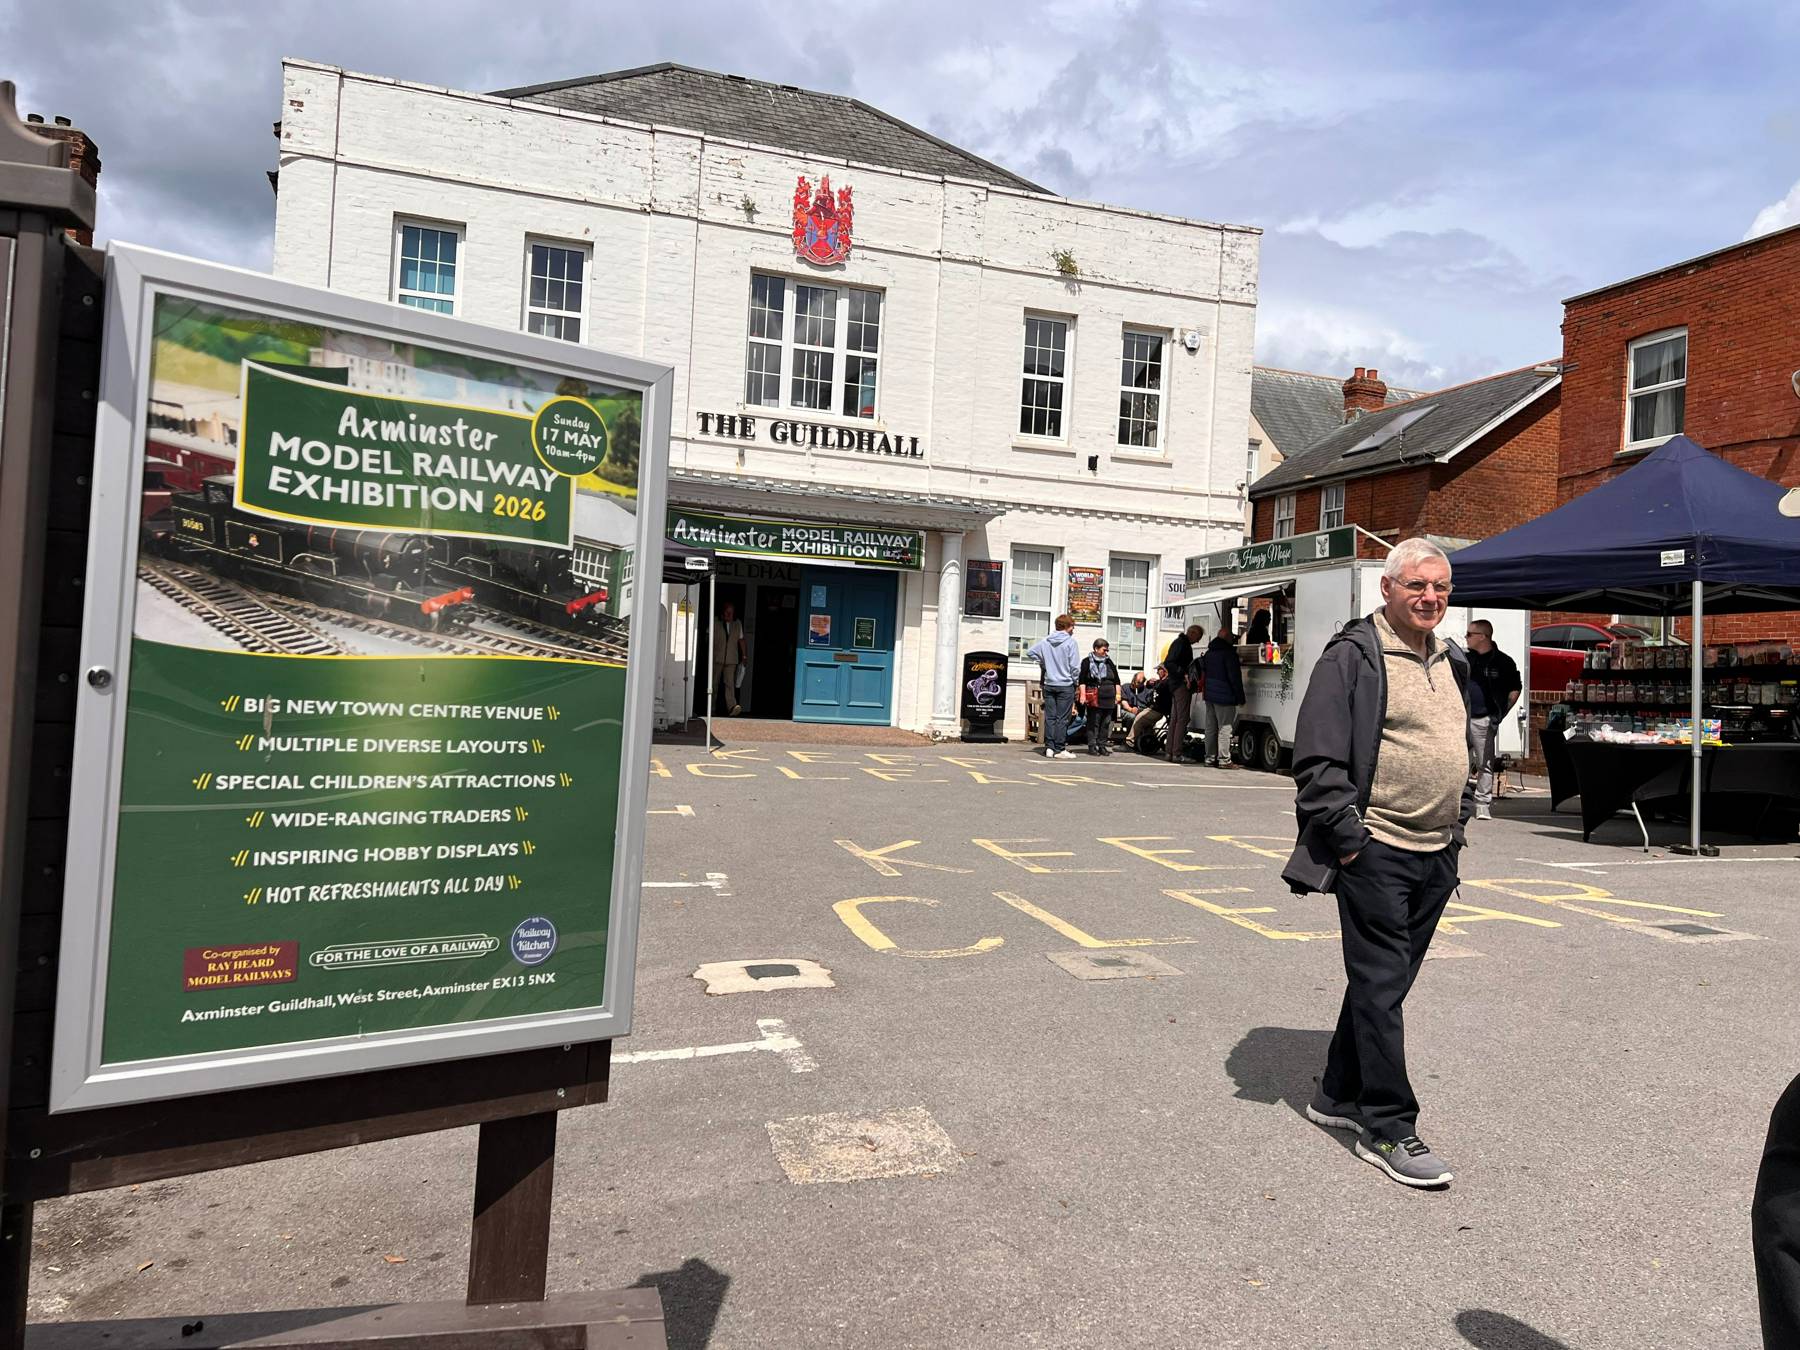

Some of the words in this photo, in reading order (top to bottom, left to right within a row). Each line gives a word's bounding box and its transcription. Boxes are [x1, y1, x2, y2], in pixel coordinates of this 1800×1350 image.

[338, 406, 498, 451] Axminster
[554, 413, 590, 432] Sunday
[543, 427, 559, 442] 17
[564, 431, 602, 449] MAY
[697, 411, 756, 439] THE
[770, 421, 923, 459] GUILDHALL
[269, 431, 403, 475] MODEL
[413, 452, 560, 493] RAILWAY
[268, 465, 483, 513] EXHIBITION
[493, 493, 546, 522] 2026
[673, 518, 778, 549] Axminster
[781, 527, 839, 543] MODEL
[843, 532, 913, 549] RAILWAY
[780, 541, 877, 559] EXHIBITION
[1267, 543, 1292, 562] Moose
[244, 698, 281, 713] BIG
[286, 699, 338, 715] NEW
[339, 701, 404, 717] TOWN
[408, 703, 482, 719] CENTRE
[484, 705, 544, 720] VENUE
[258, 736, 358, 752] MULTIPLE
[363, 738, 442, 753] DIVERSE
[446, 739, 528, 754] LAYOUTS
[709, 747, 998, 769] KEEP
[215, 774, 304, 790] SPECIAL
[309, 774, 427, 790] CHILDREN'S
[429, 774, 556, 789] ATTRACTIONS
[271, 811, 427, 828] WIDE-RANGING
[429, 809, 512, 824] TRADERS
[253, 848, 358, 866] INSPIRING
[363, 845, 432, 862] HOBBY
[436, 842, 519, 859] DISPLAYS
[266, 885, 305, 904] HOT
[308, 878, 440, 902] REFRESHMENTS
[443, 877, 470, 894] ALL
[474, 875, 504, 892] DAY
[517, 927, 551, 939] Railway
[202, 946, 267, 960] Co-organised
[269, 946, 281, 956] by
[316, 951, 343, 964] FOR
[344, 949, 372, 960] THE
[374, 946, 407, 959] LOVE
[410, 945, 428, 955] OF
[429, 944, 439, 954] A
[441, 939, 494, 953] RAILWAY
[516, 939, 551, 951] Kitchen
[207, 960, 231, 972] RAY
[233, 958, 275, 970] HEARD
[187, 974, 232, 987] MODEL
[233, 968, 292, 983] RAILWAYS
[181, 1005, 265, 1023] Axminster
[268, 994, 336, 1013] Guildhall,
[337, 993, 373, 1006] West
[376, 985, 422, 1001] Street,
[422, 982, 489, 998] Axminster
[492, 975, 525, 990] EX13
[527, 972, 556, 986] 5NX
